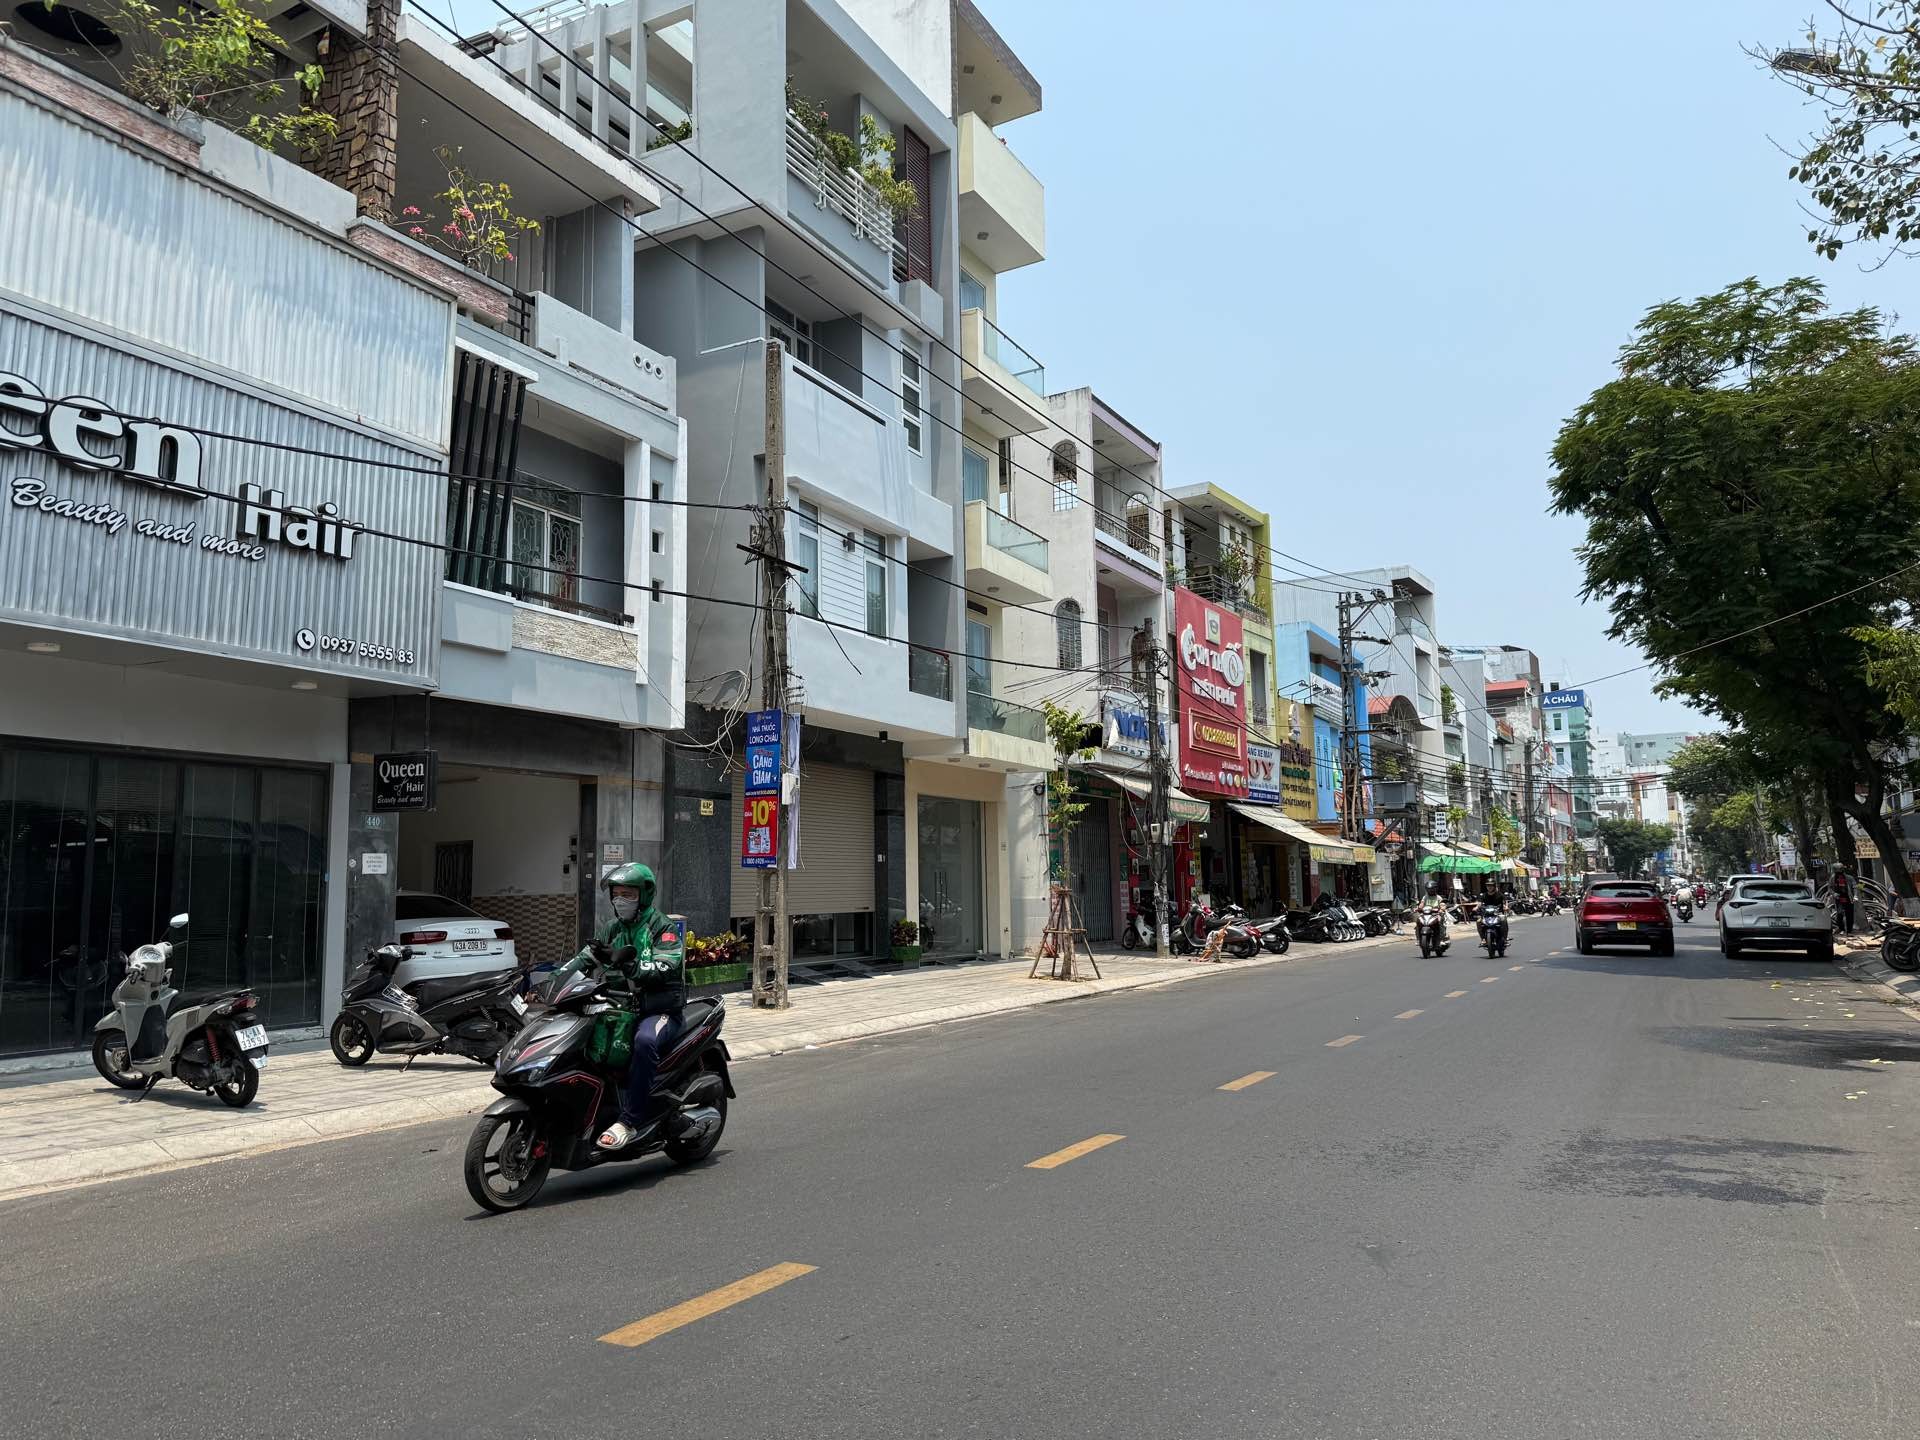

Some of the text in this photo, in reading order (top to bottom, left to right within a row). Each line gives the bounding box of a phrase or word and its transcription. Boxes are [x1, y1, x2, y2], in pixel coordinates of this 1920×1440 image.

[12, 476, 266, 562] Beauty and more
[239, 483, 364, 560] Hair
[320, 634, 415, 665] 0937 5555 83
[1551, 694, 1578, 704] CHÂU
[379, 760, 425, 783] Queen
[406, 781, 425, 793] Hair
[366, 816, 381, 826] 440
